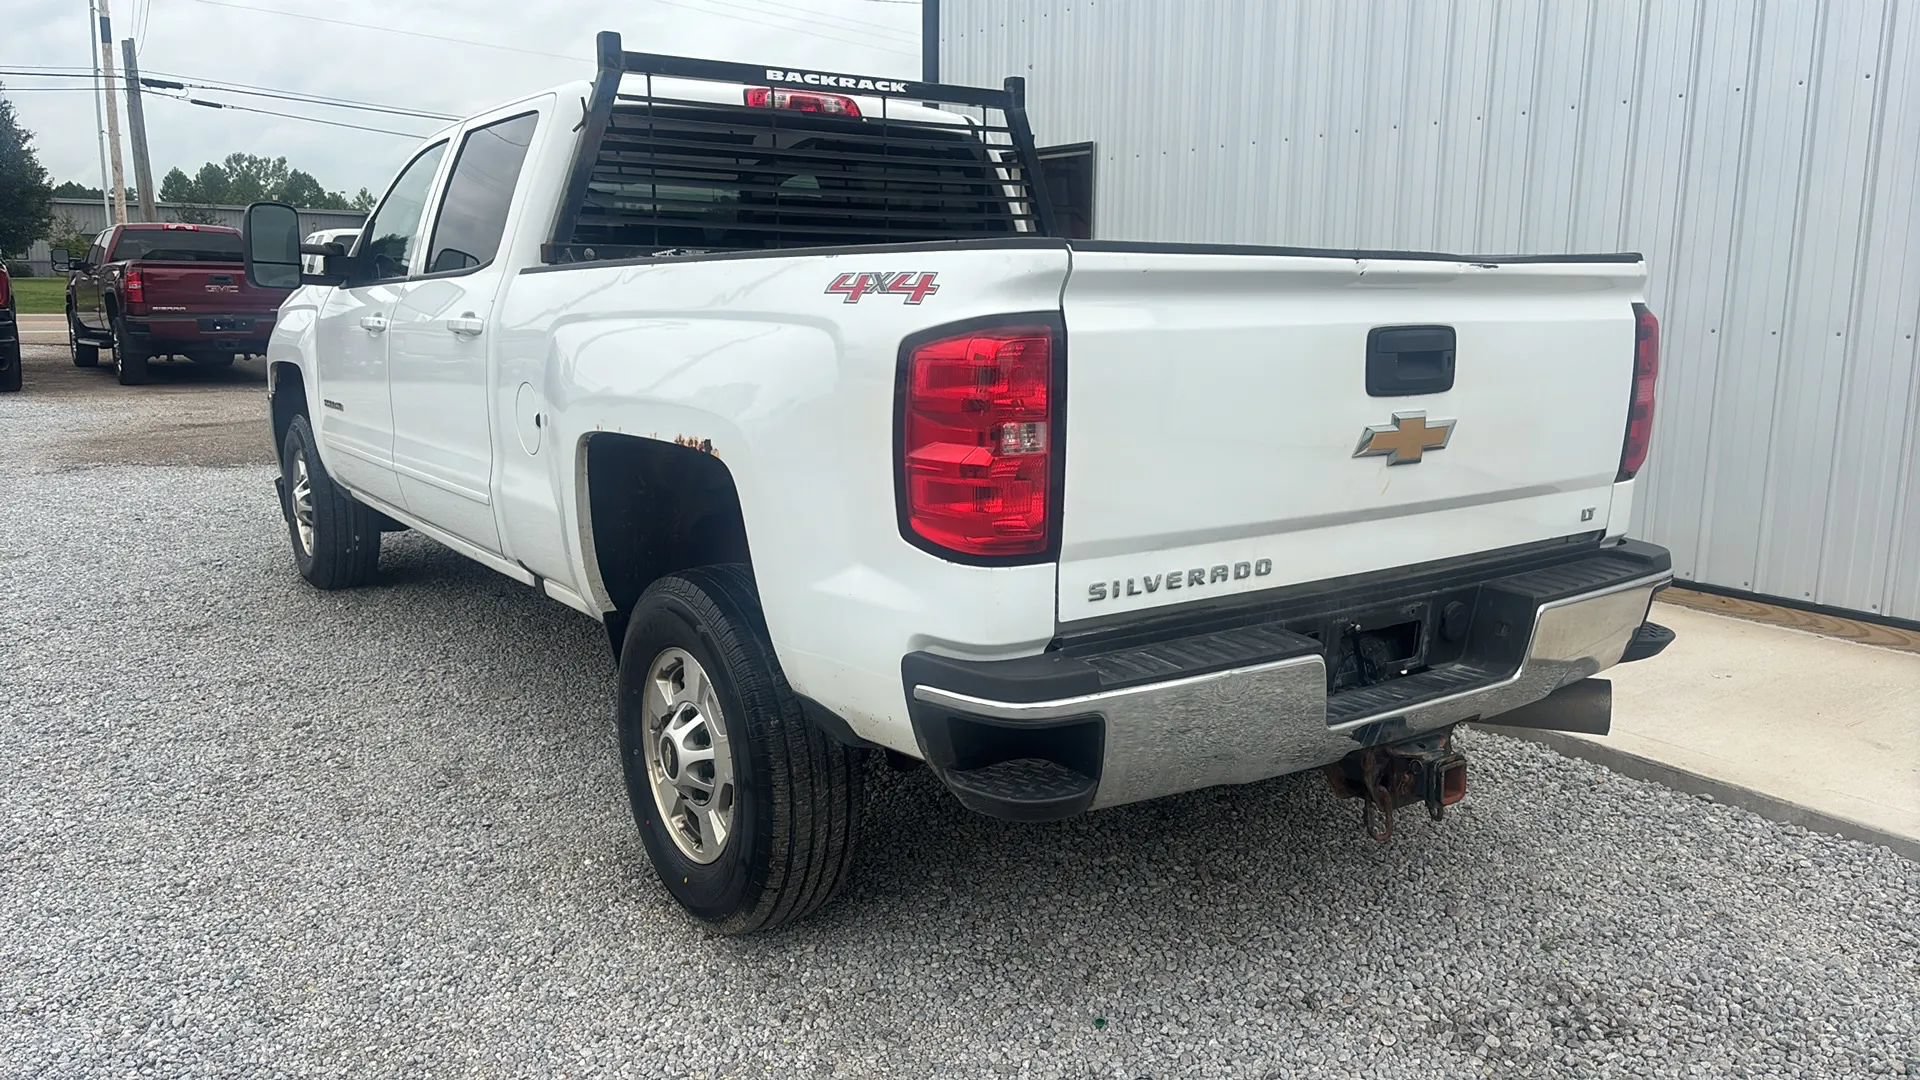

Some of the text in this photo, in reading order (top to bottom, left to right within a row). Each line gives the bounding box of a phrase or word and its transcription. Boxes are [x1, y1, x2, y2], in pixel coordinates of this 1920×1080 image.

[765, 69, 907, 93] BACKRACK
[1581, 507, 1596, 521] LT
[1088, 558, 1273, 602] SILVERADO
